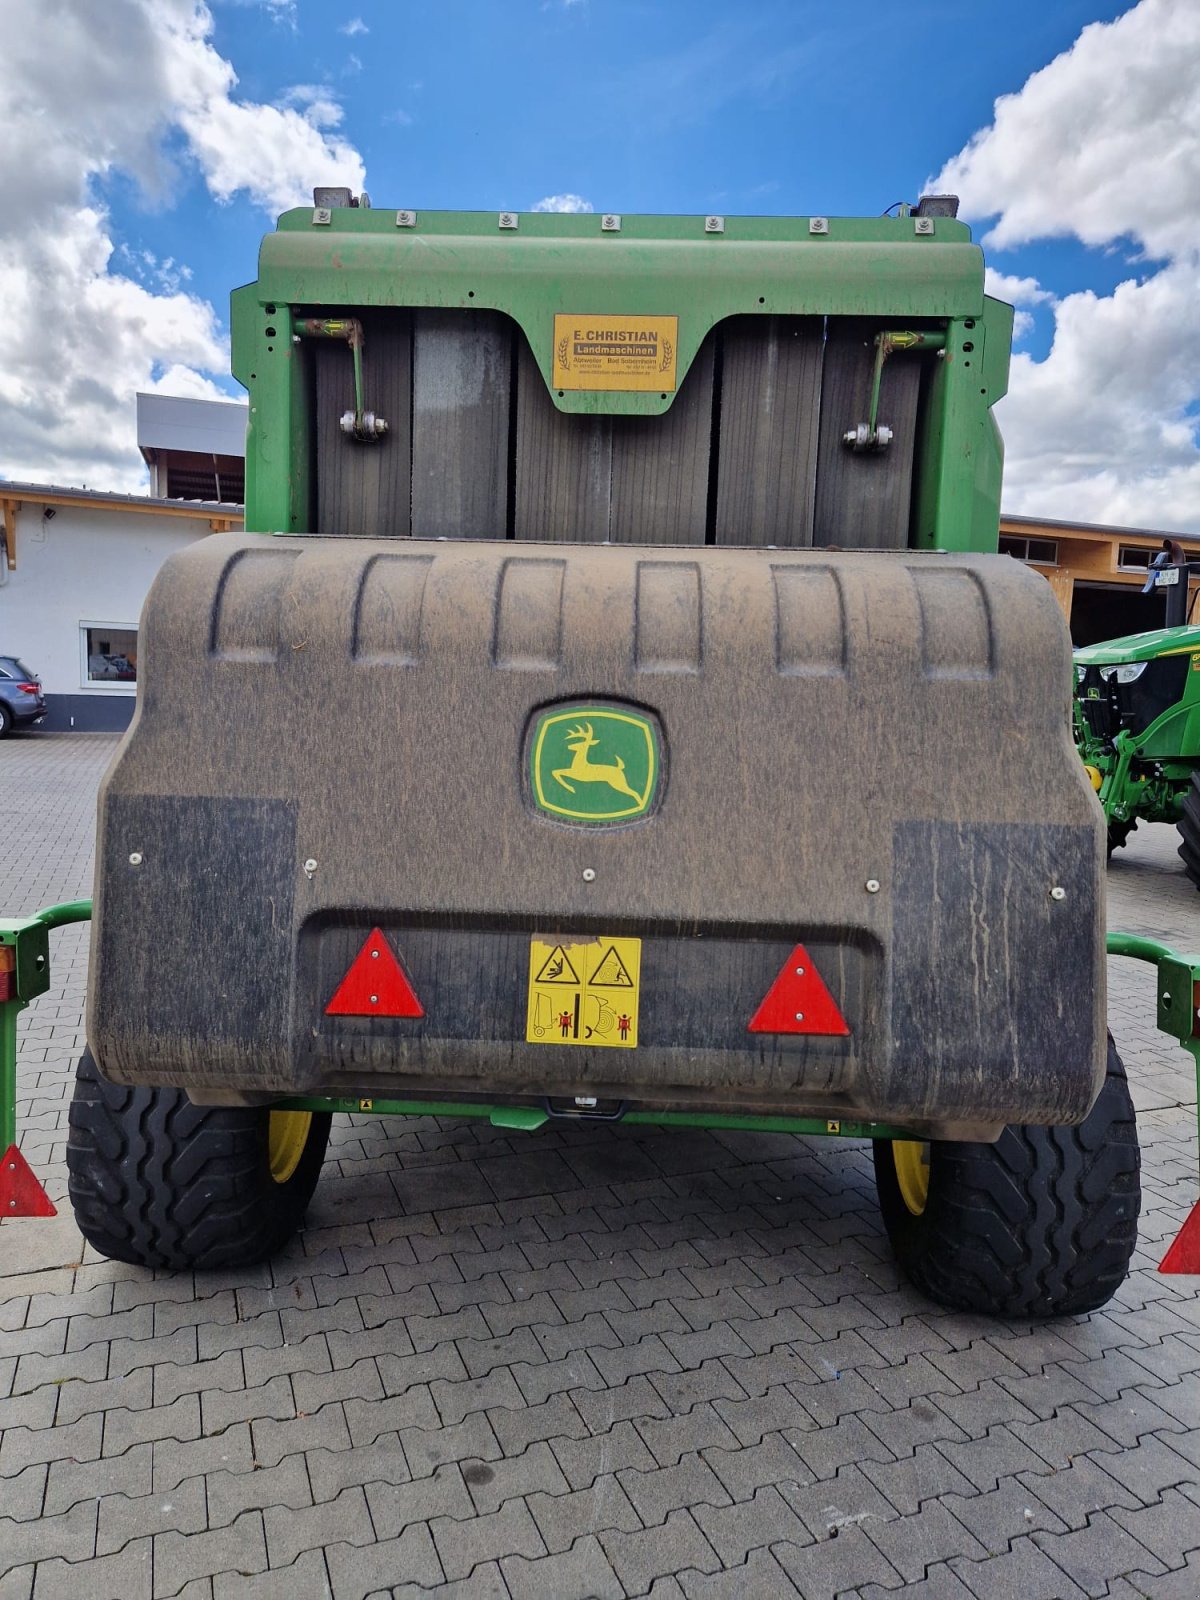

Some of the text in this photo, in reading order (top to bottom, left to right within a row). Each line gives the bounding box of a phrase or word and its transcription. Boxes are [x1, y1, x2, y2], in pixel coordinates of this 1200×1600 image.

[574, 330, 658, 342] E. CHRISTIAN
[577, 345, 654, 355] Landmaschinen
